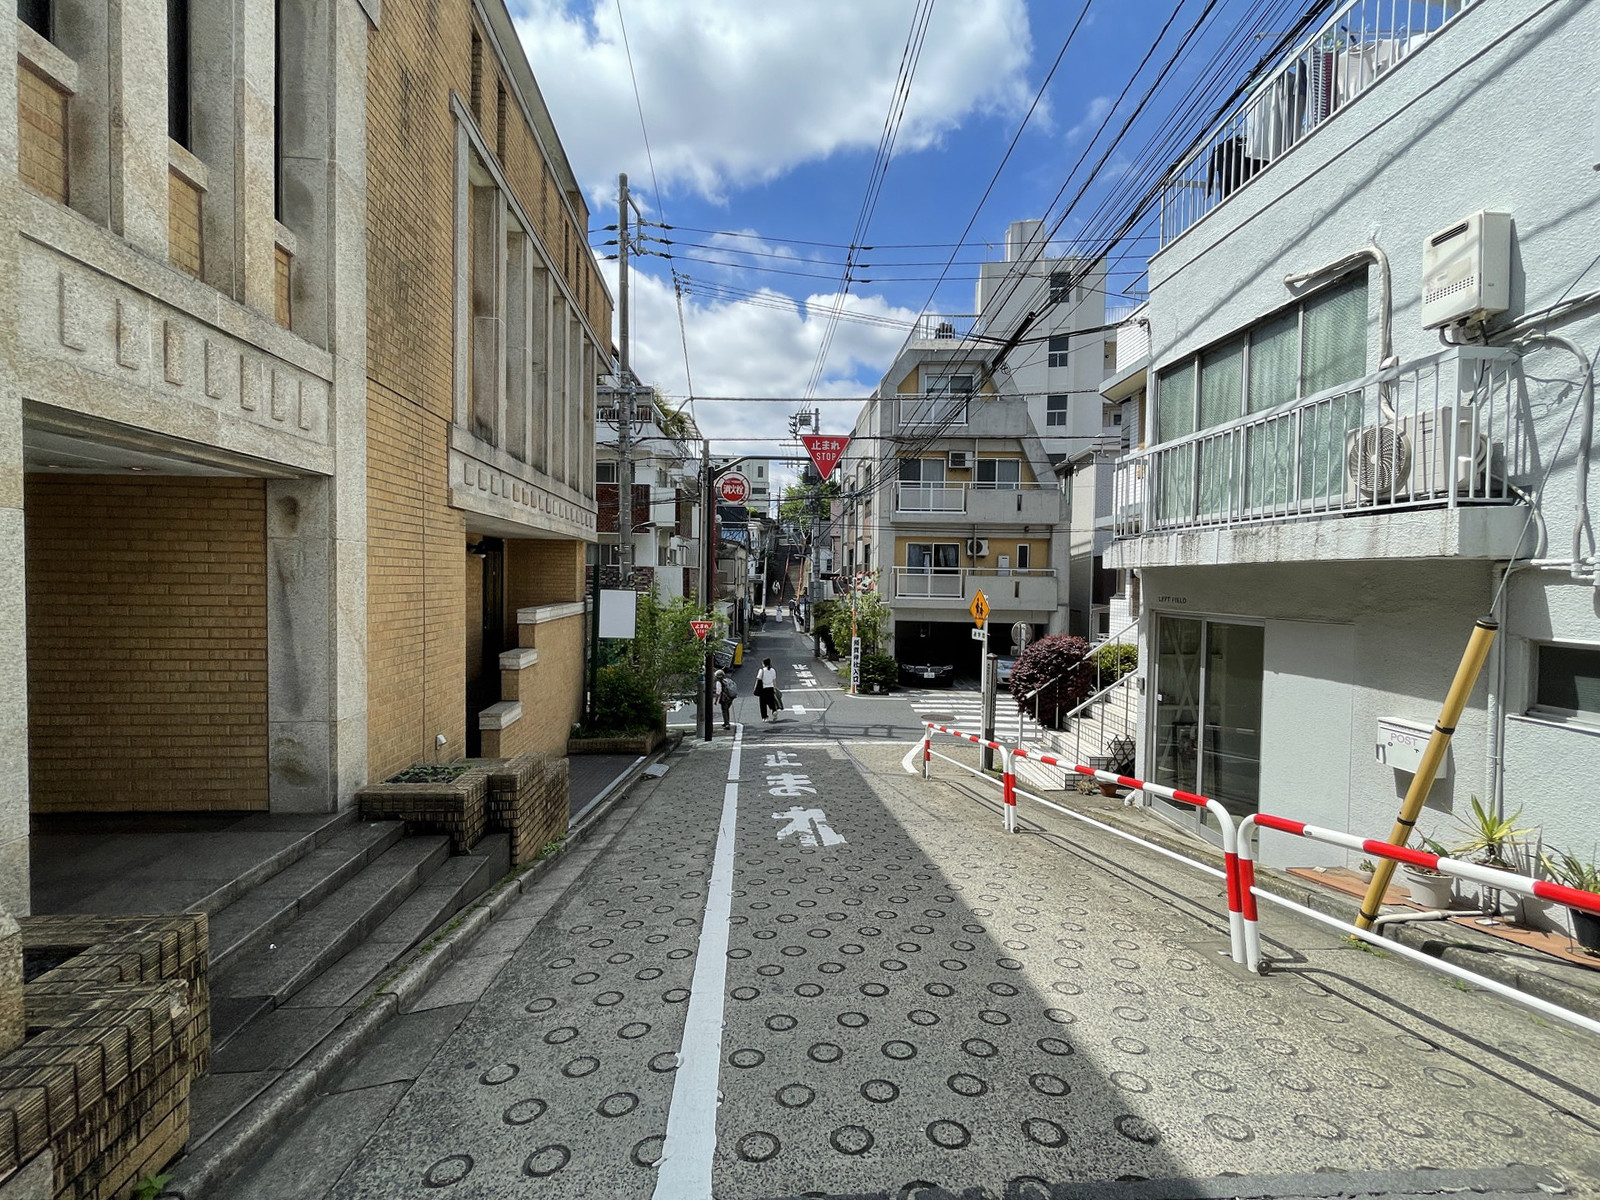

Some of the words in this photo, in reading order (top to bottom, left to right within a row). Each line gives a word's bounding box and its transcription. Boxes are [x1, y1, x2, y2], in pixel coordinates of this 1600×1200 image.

[811, 440, 840, 450] 止まれ
[816, 452, 837, 461] STOP
[723, 484, 744, 495] 消火栓
[1390, 732, 1418, 747] POST
[764, 750, 848, 846] 止まれ
